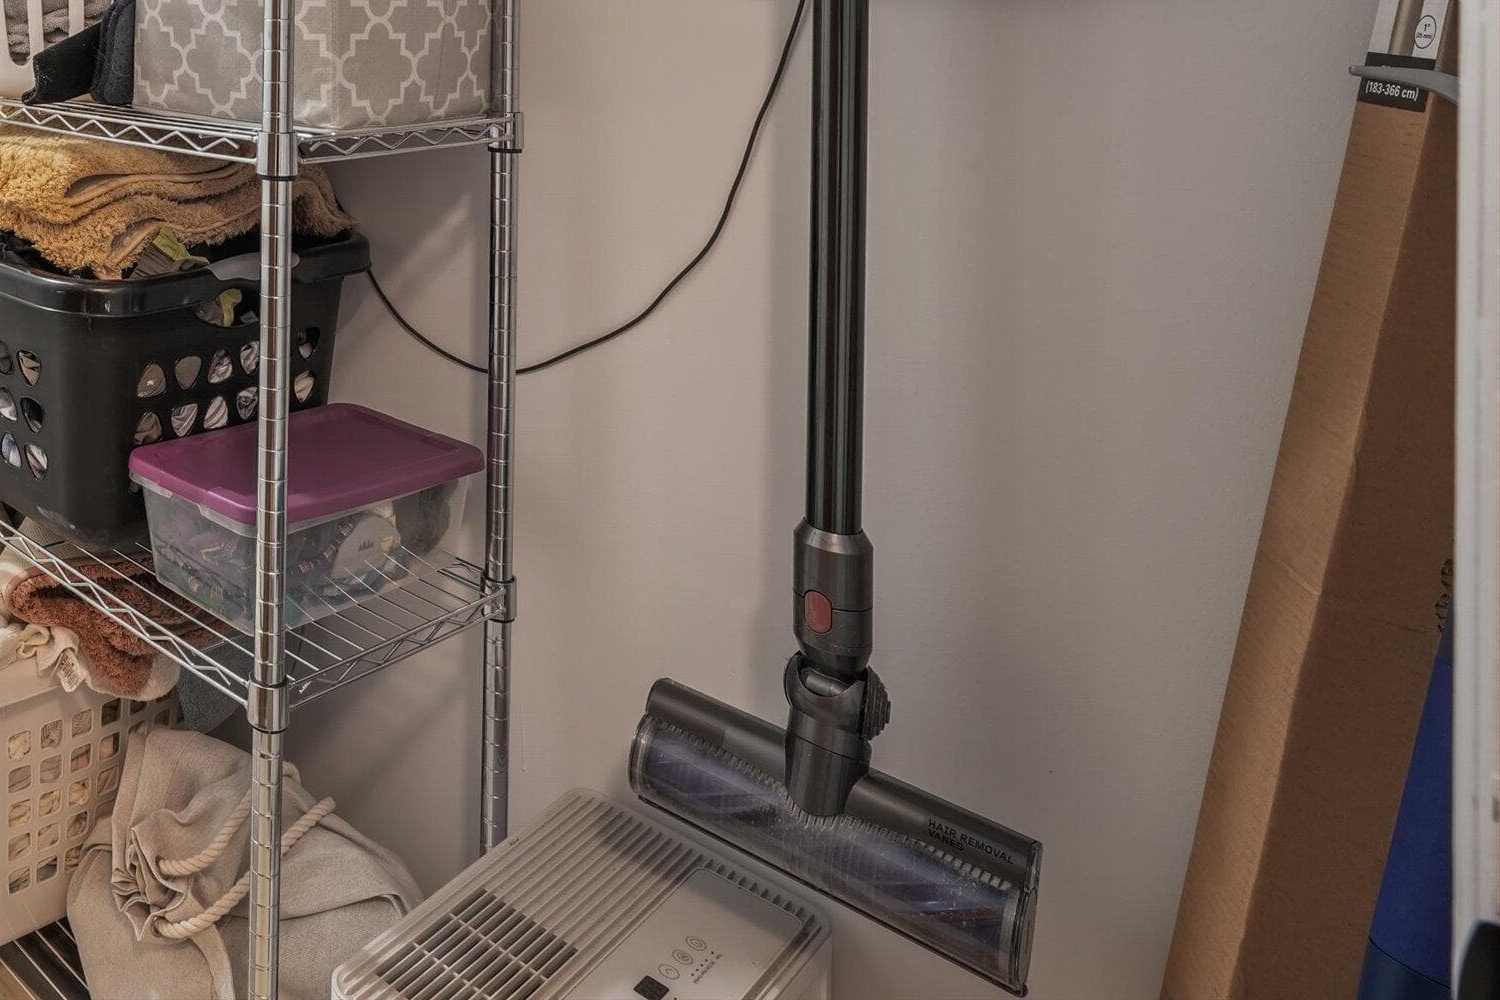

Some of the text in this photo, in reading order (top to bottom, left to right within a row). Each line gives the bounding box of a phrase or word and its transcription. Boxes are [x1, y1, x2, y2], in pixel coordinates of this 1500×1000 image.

[1365, 80, 1419, 102] (183-366 cm)
[927, 829, 964, 851] VANES
[927, 819, 1015, 864] HAIR REMOVAL
